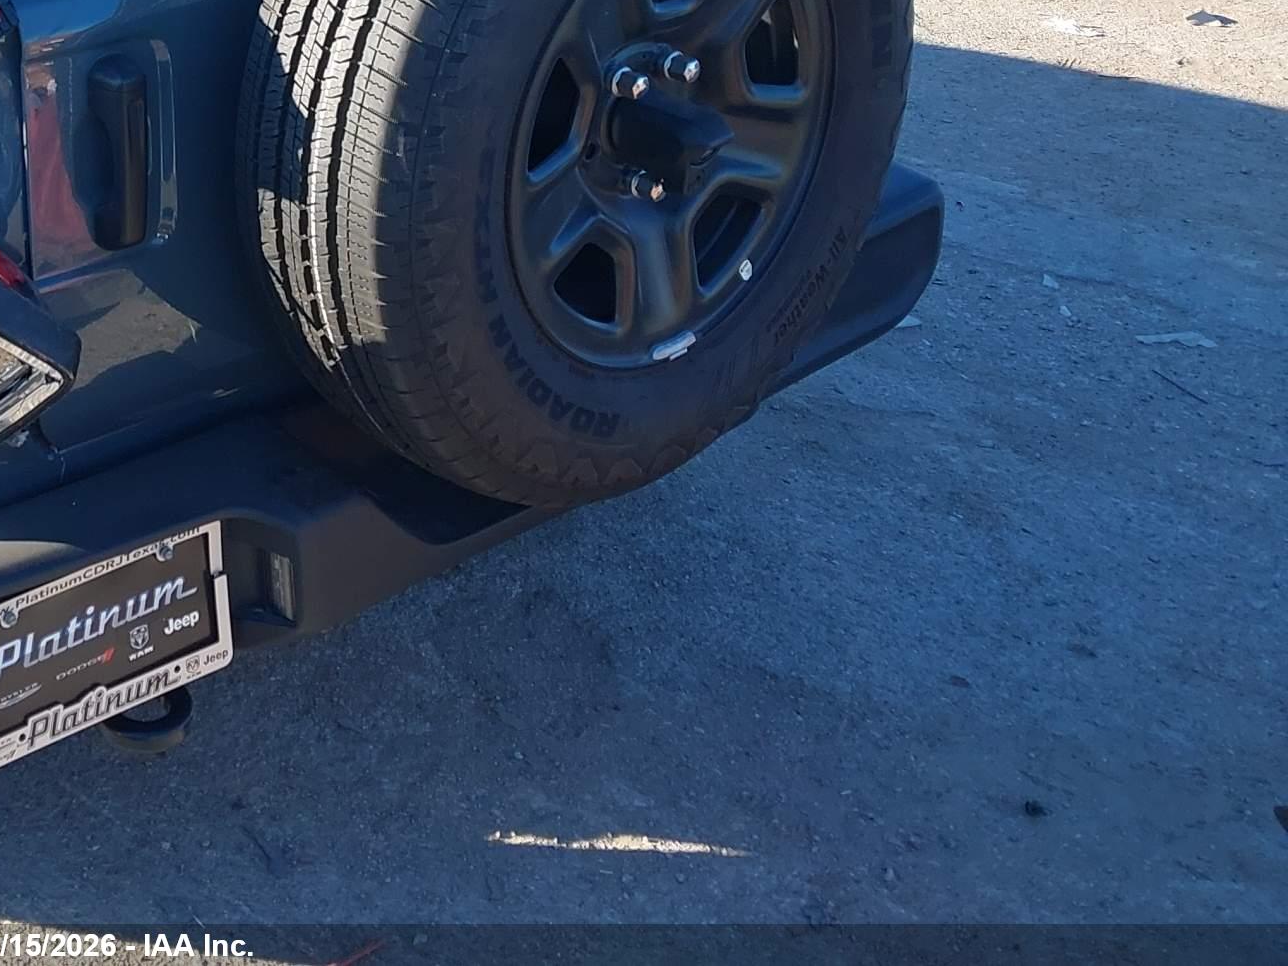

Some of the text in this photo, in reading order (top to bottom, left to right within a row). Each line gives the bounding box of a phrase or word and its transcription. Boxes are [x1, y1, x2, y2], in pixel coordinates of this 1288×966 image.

[164, 611, 200, 635] Jeep
[203, 649, 229, 666] Jeep
[28, 669, 181, 747] Platinum
